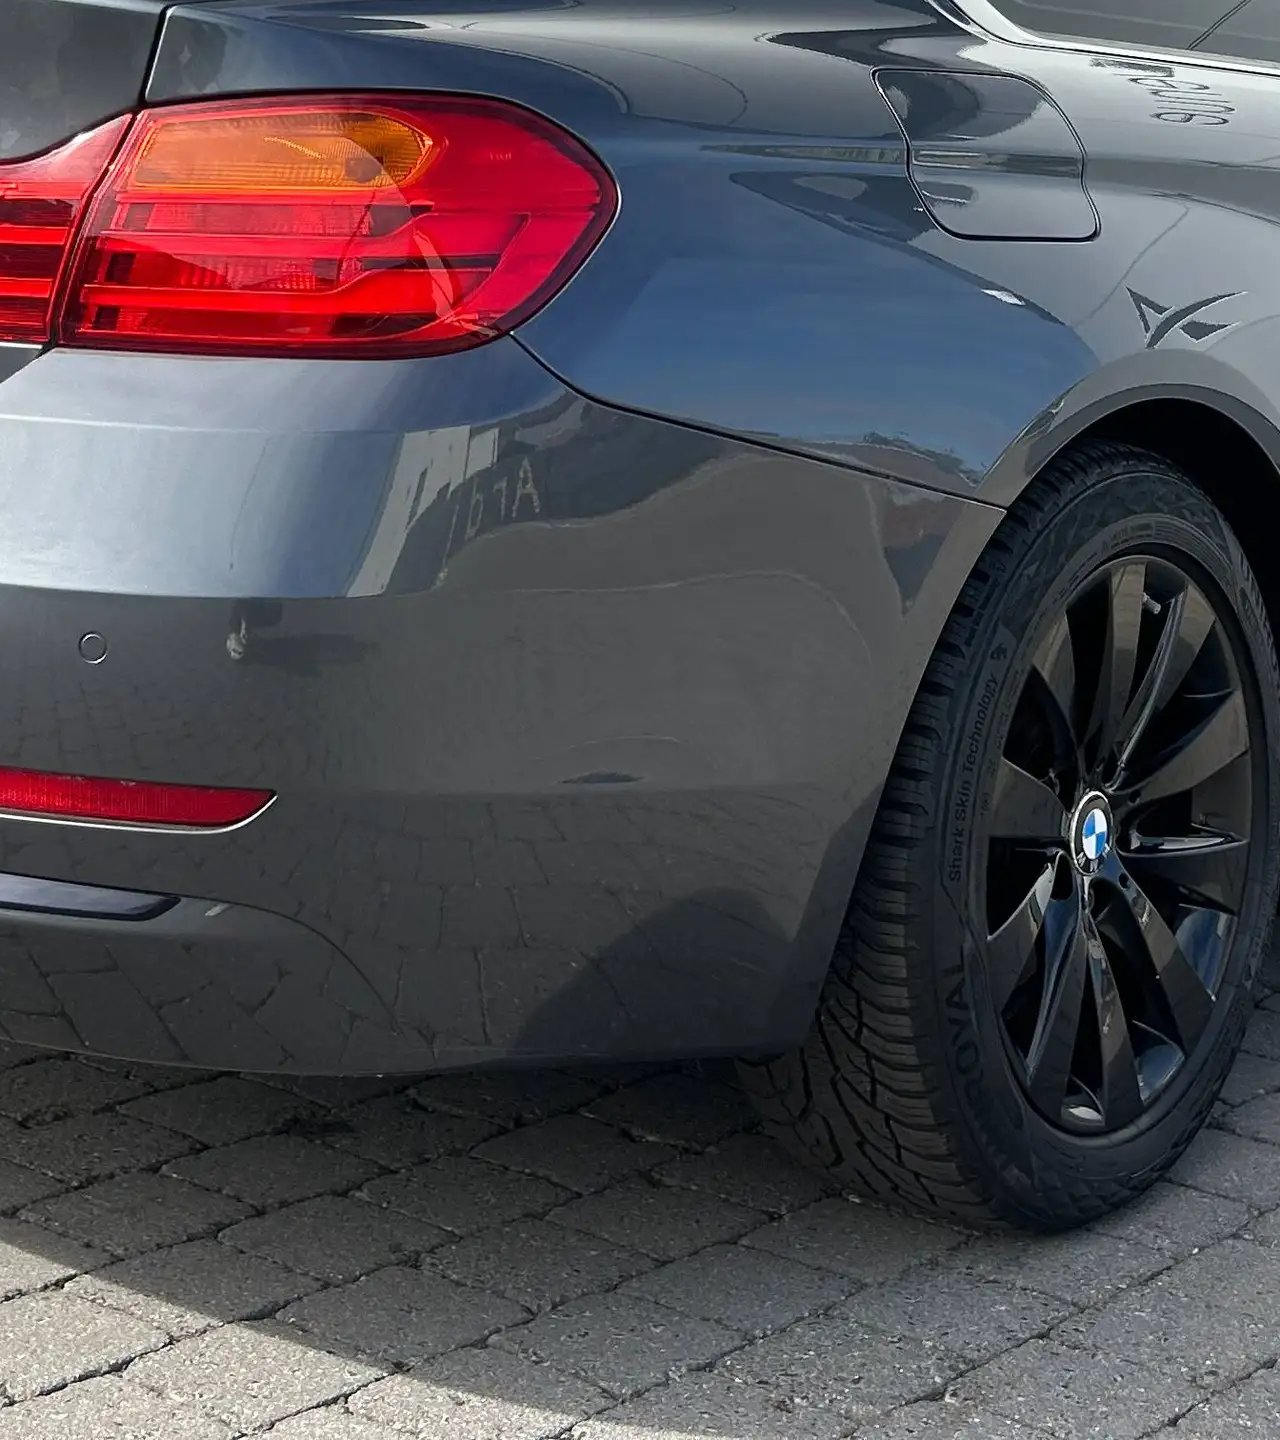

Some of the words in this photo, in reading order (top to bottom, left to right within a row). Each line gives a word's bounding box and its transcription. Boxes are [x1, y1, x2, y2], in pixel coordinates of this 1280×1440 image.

[960, 669, 999, 775] Technology
[951, 776, 972, 822] Skin
[946, 827, 965, 882] Shark
